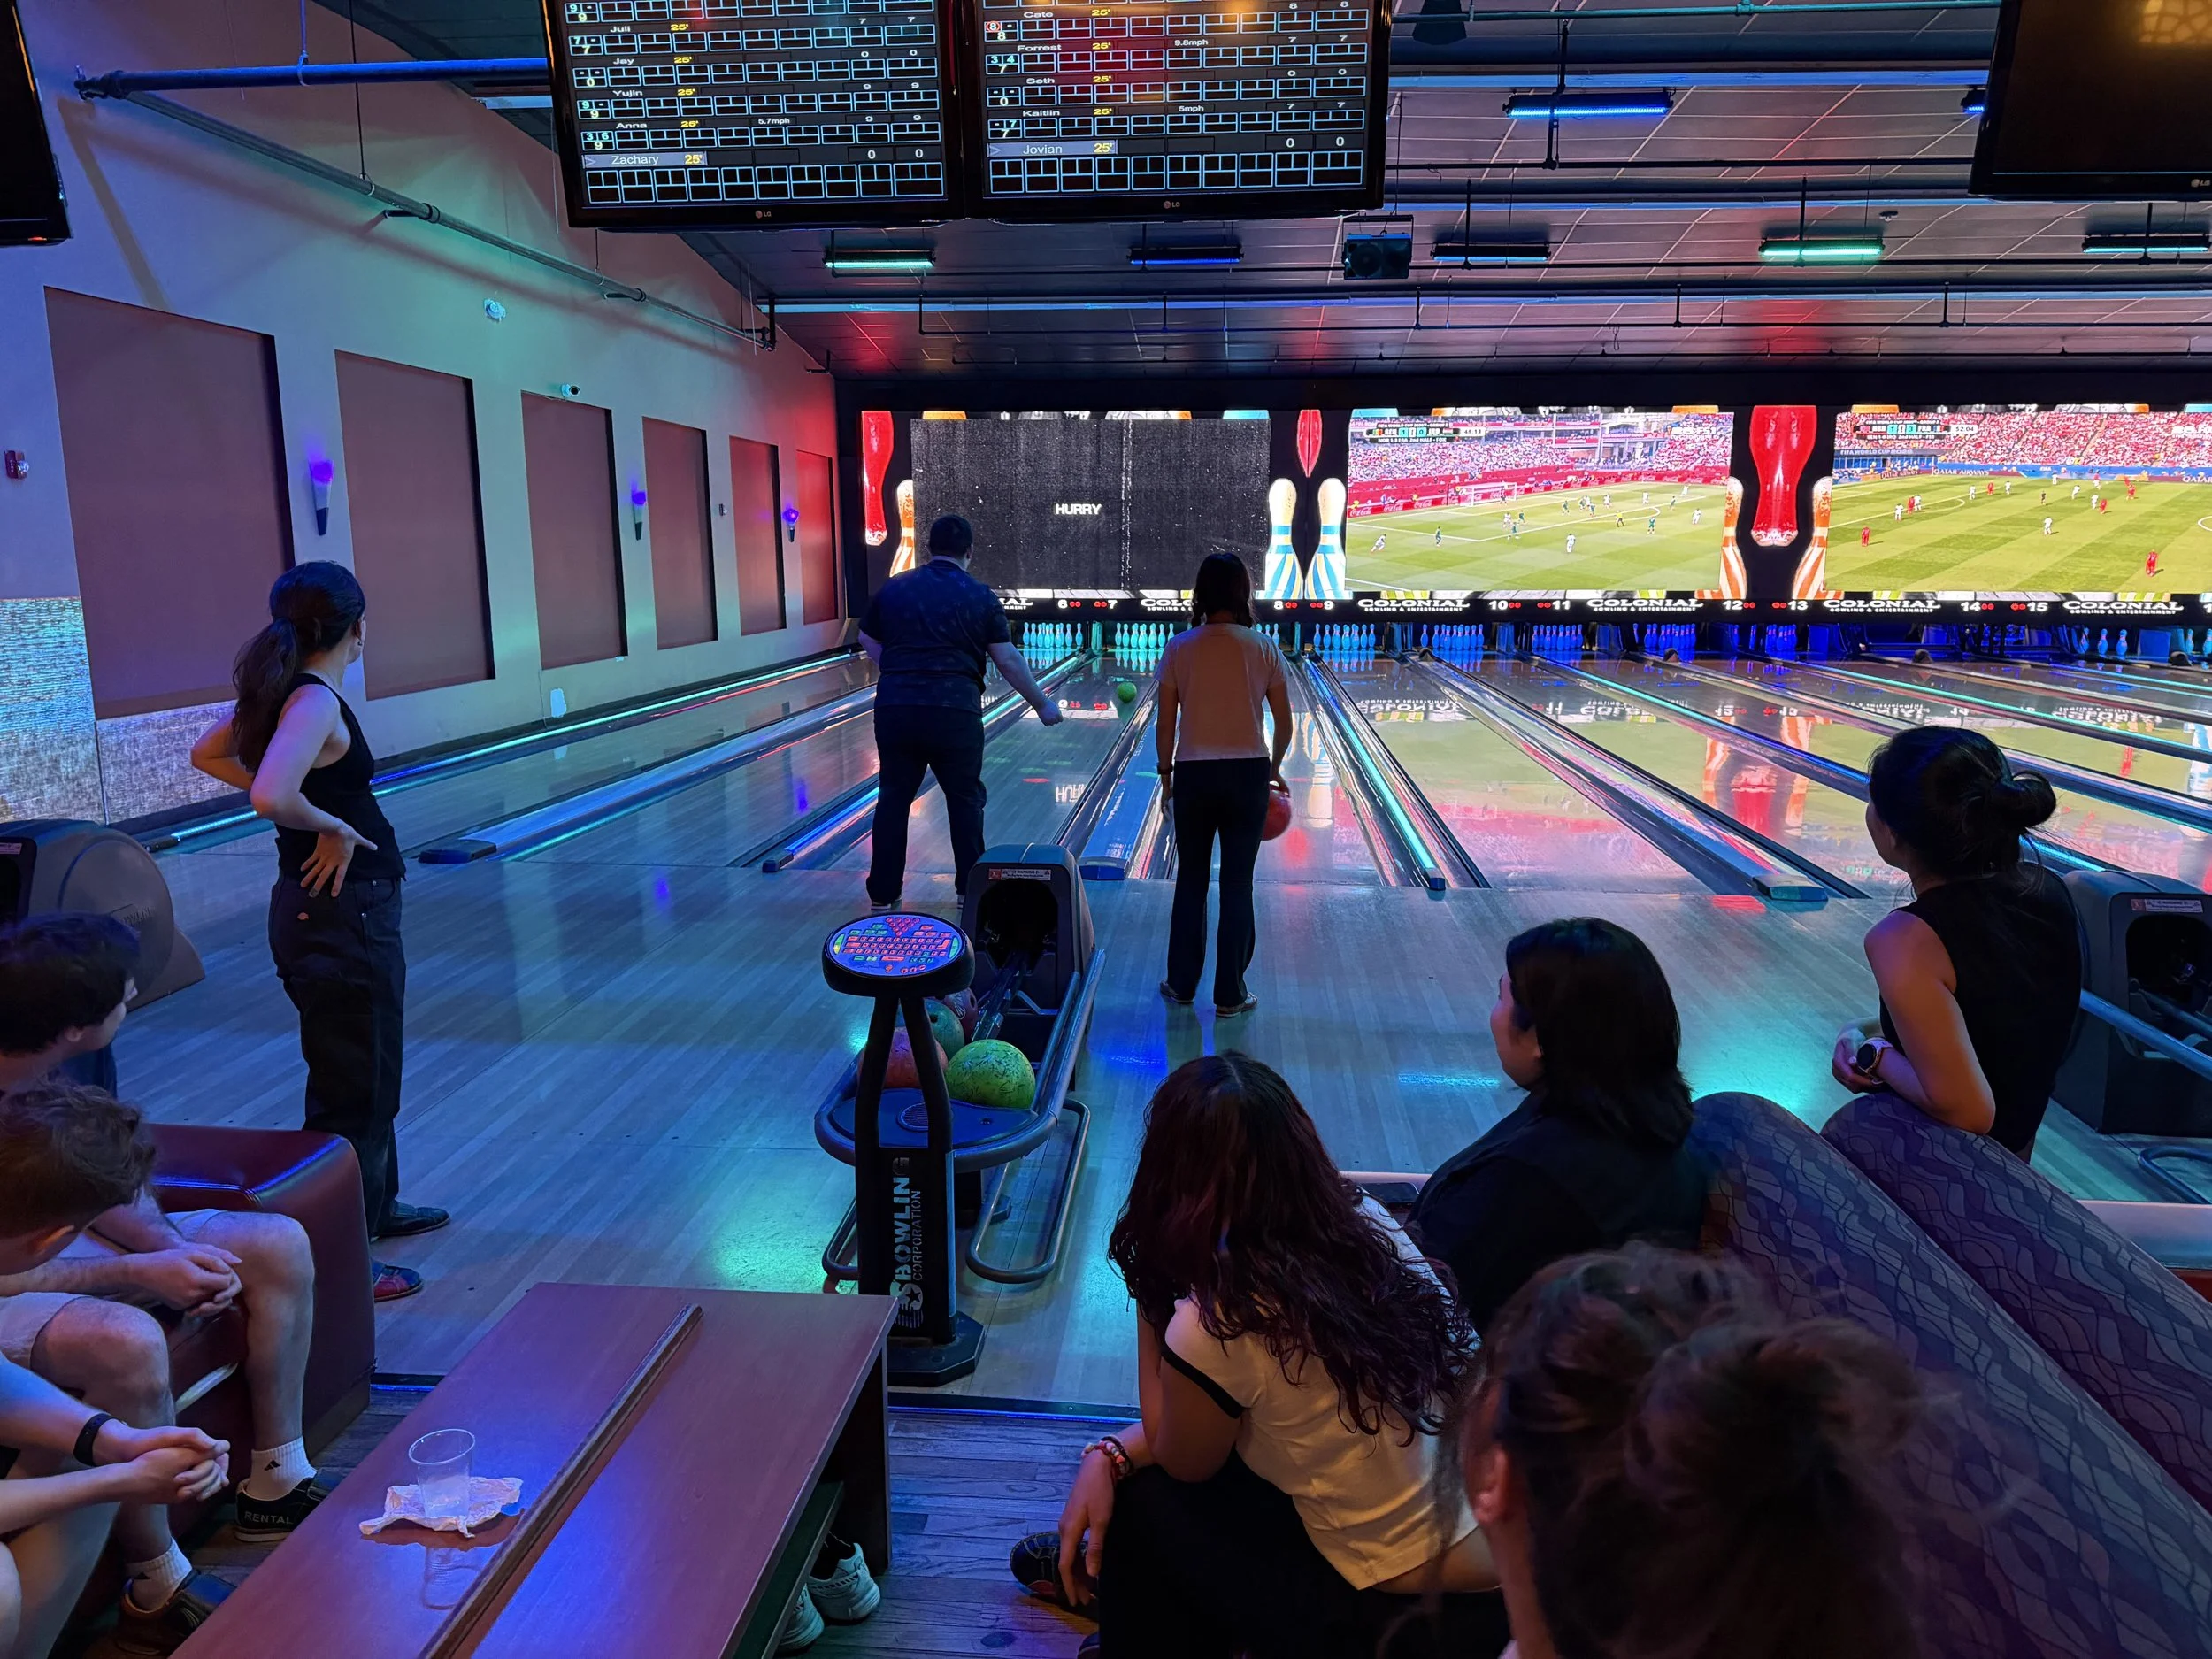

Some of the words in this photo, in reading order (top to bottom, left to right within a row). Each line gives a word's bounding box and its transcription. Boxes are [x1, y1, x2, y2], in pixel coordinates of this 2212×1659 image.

[578, 13, 587, 22] 9
[997, 32, 1006, 41] 8
[582, 45, 591, 54] 7
[998, 65, 1007, 73] 7
[590, 110, 599, 119] 9
[1001, 129, 1010, 138] 7
[1023, 145, 1062, 155] Jovian
[1286, 138, 1294, 148] 0
[1336, 136, 1344, 146] 0
[611, 156, 658, 165] Zachary
[867, 150, 876, 159] 0
[915, 149, 923, 158] 0
[1055, 503, 1102, 515] HURRY
[1109, 600, 1118, 609] 7
[1325, 601, 1334, 610] 9
[1489, 601, 1508, 610] 10
[1552, 601, 1571, 610] 11
[1723, 601, 1745, 610] 12
[1787, 601, 1809, 611] 13
[1823, 600, 1940, 609] COLONIAL
[1961, 601, 1981, 611] 14
[2027, 602, 2048, 611] 15
[2063, 601, 2184, 611] COLONIAL
[893, 1157, 911, 1281] BOWLING
[911, 1190, 922, 1281] CORPORATION
[244, 1511, 294, 1525] RENTAL
